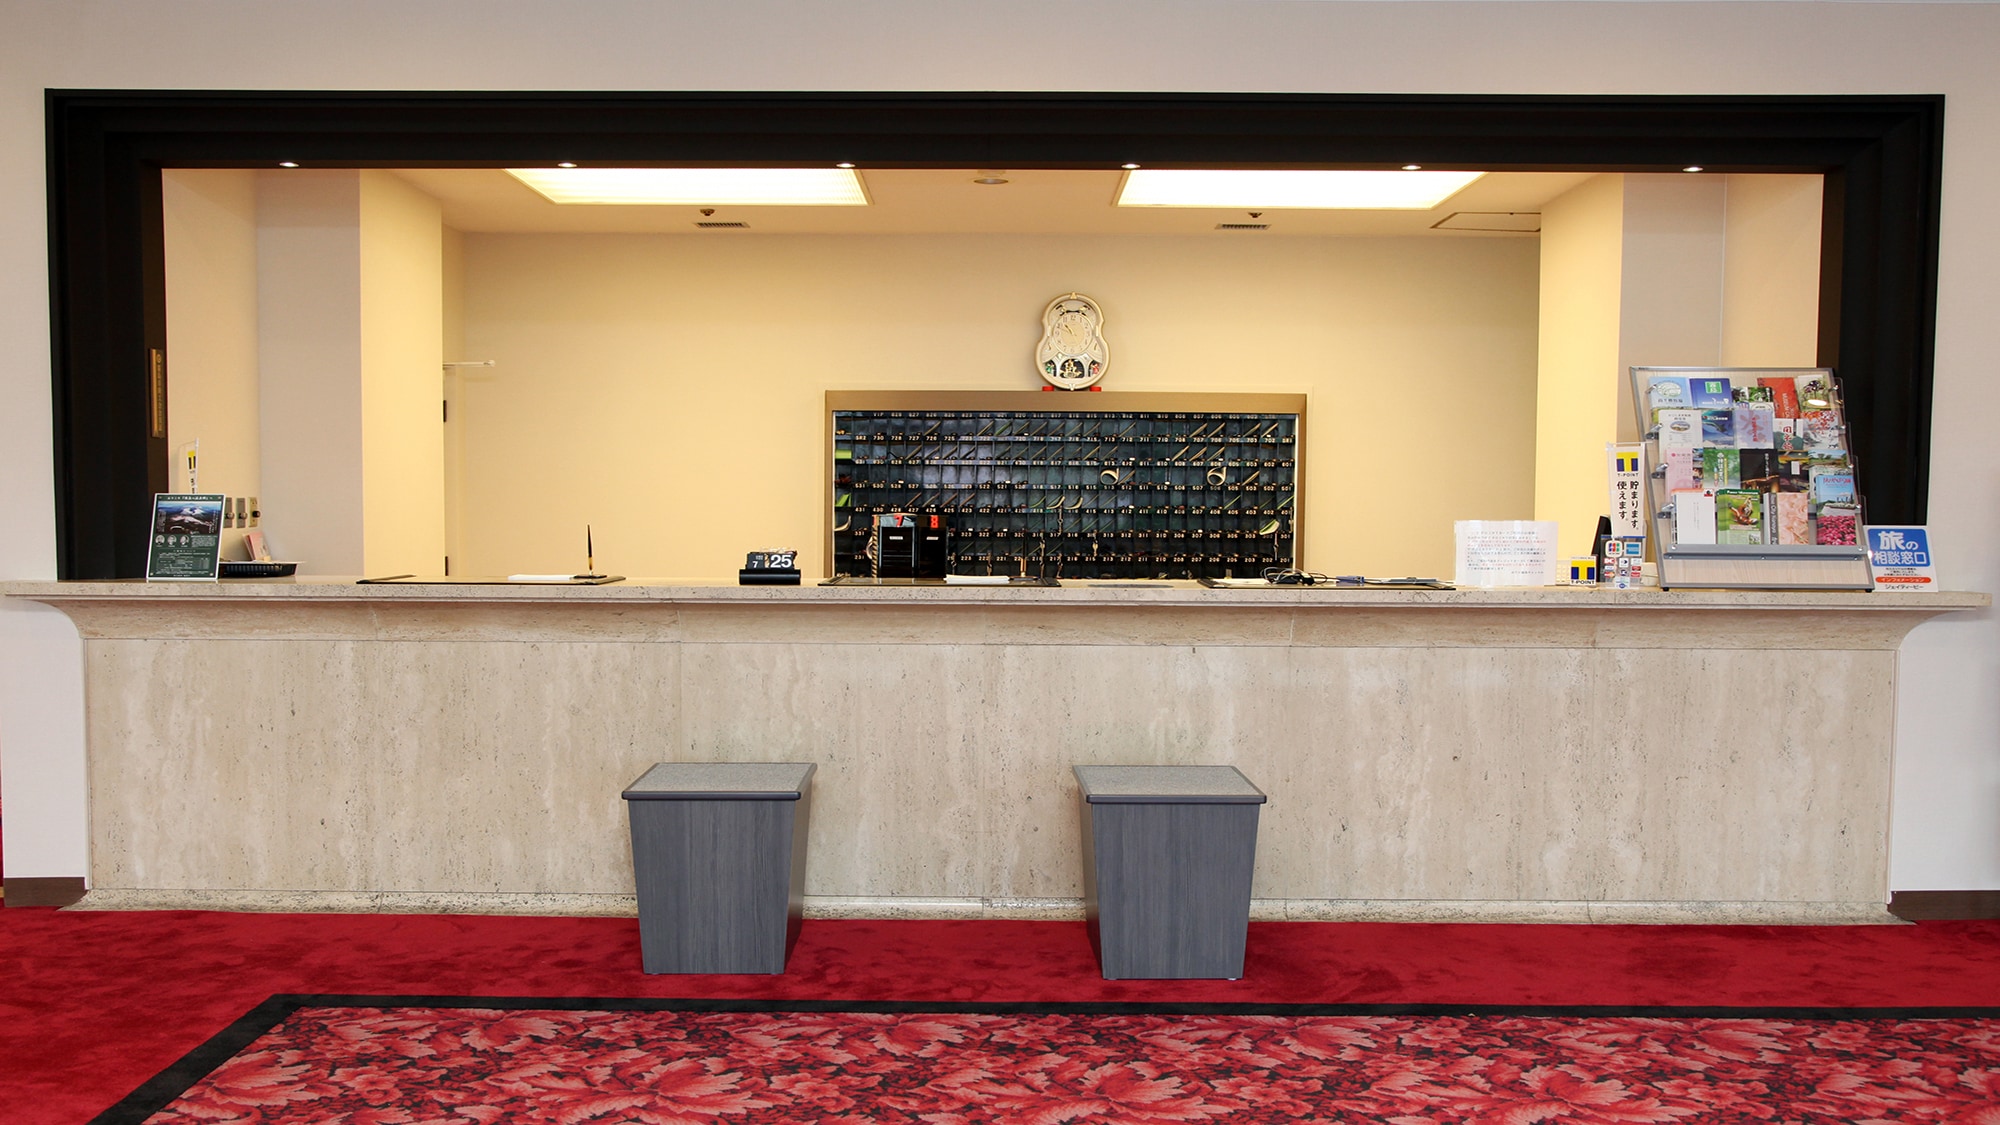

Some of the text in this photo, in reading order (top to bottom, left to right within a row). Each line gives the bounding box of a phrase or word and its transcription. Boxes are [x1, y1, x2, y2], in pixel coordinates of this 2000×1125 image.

[1617, 481, 1628, 520] 使えます。
[1630, 481, 1639, 530] 貯まります。
[894, 515, 938, 528] 7 8
[1878, 531, 1918, 550] 旅の
[770, 554, 792, 568] 25
[1874, 551, 1927, 565] 相談窓口
